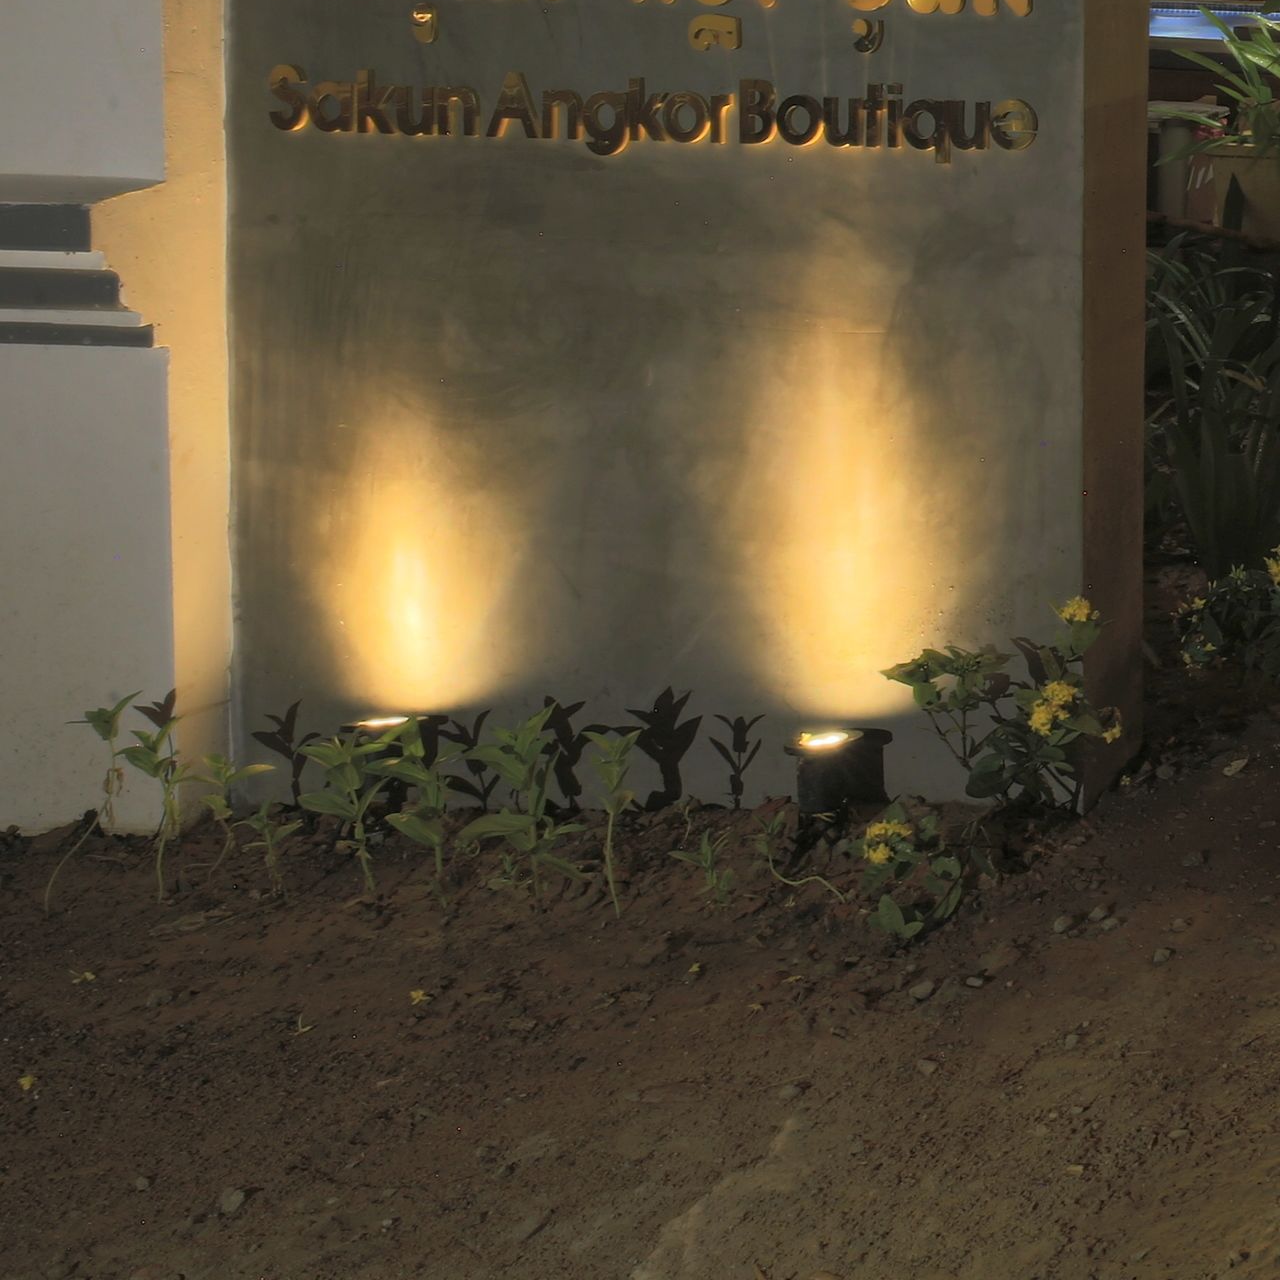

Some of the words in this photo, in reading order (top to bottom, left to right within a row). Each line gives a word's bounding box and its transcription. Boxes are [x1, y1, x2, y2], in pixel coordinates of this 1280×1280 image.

[268, 63, 481, 137] Sakun
[485, 70, 734, 156] Angkor
[738, 78, 1038, 164] Boutique
